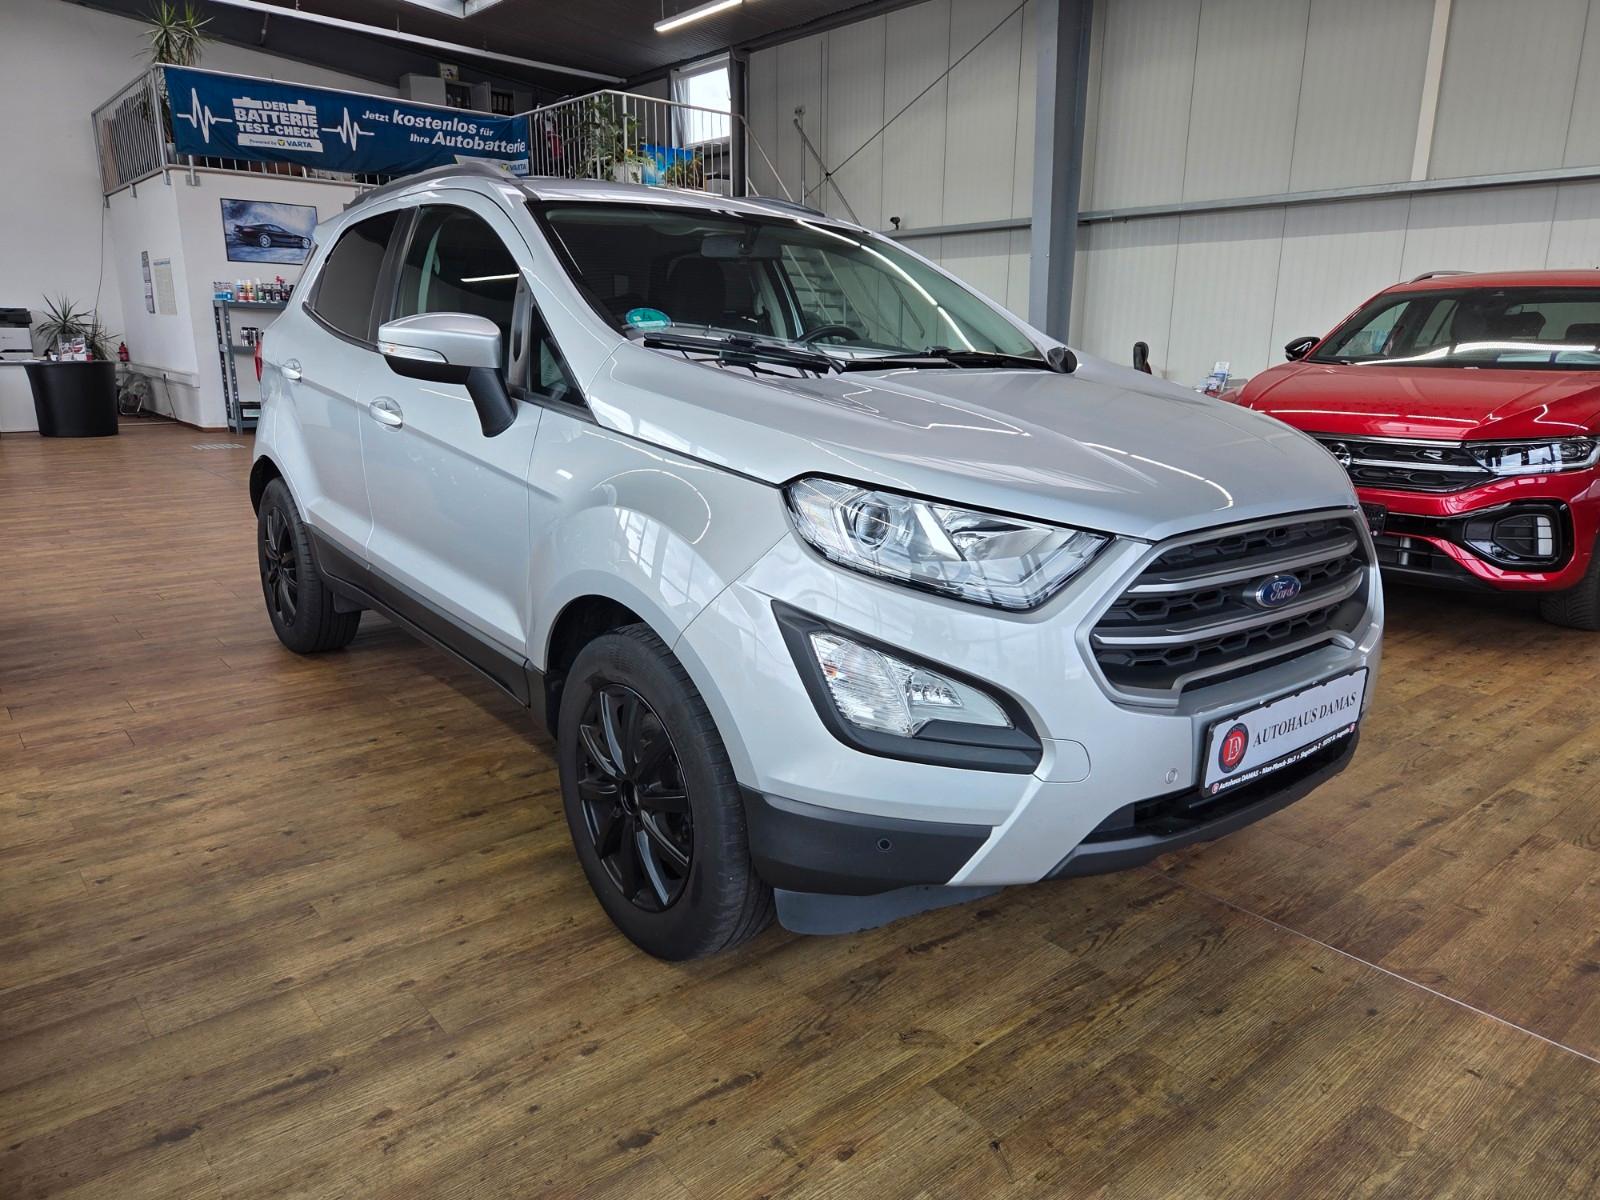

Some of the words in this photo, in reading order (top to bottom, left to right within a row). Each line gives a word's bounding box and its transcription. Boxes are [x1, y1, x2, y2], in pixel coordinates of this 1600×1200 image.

[263, 100, 288, 112] DER
[234, 107, 318, 128] BATTERIE
[362, 110, 389, 122] Jetzt
[392, 109, 477, 134] kostenlos
[479, 127, 494, 137] für
[236, 121, 320, 139] TEST-CHECK
[286, 140, 313, 148] VARTA
[410, 133, 430, 144] Ihre
[431, 131, 526, 153] Autobatterie
[1253, 708, 1318, 747] AUTOHAUS
[1319, 691, 1357, 719] DAMAS
